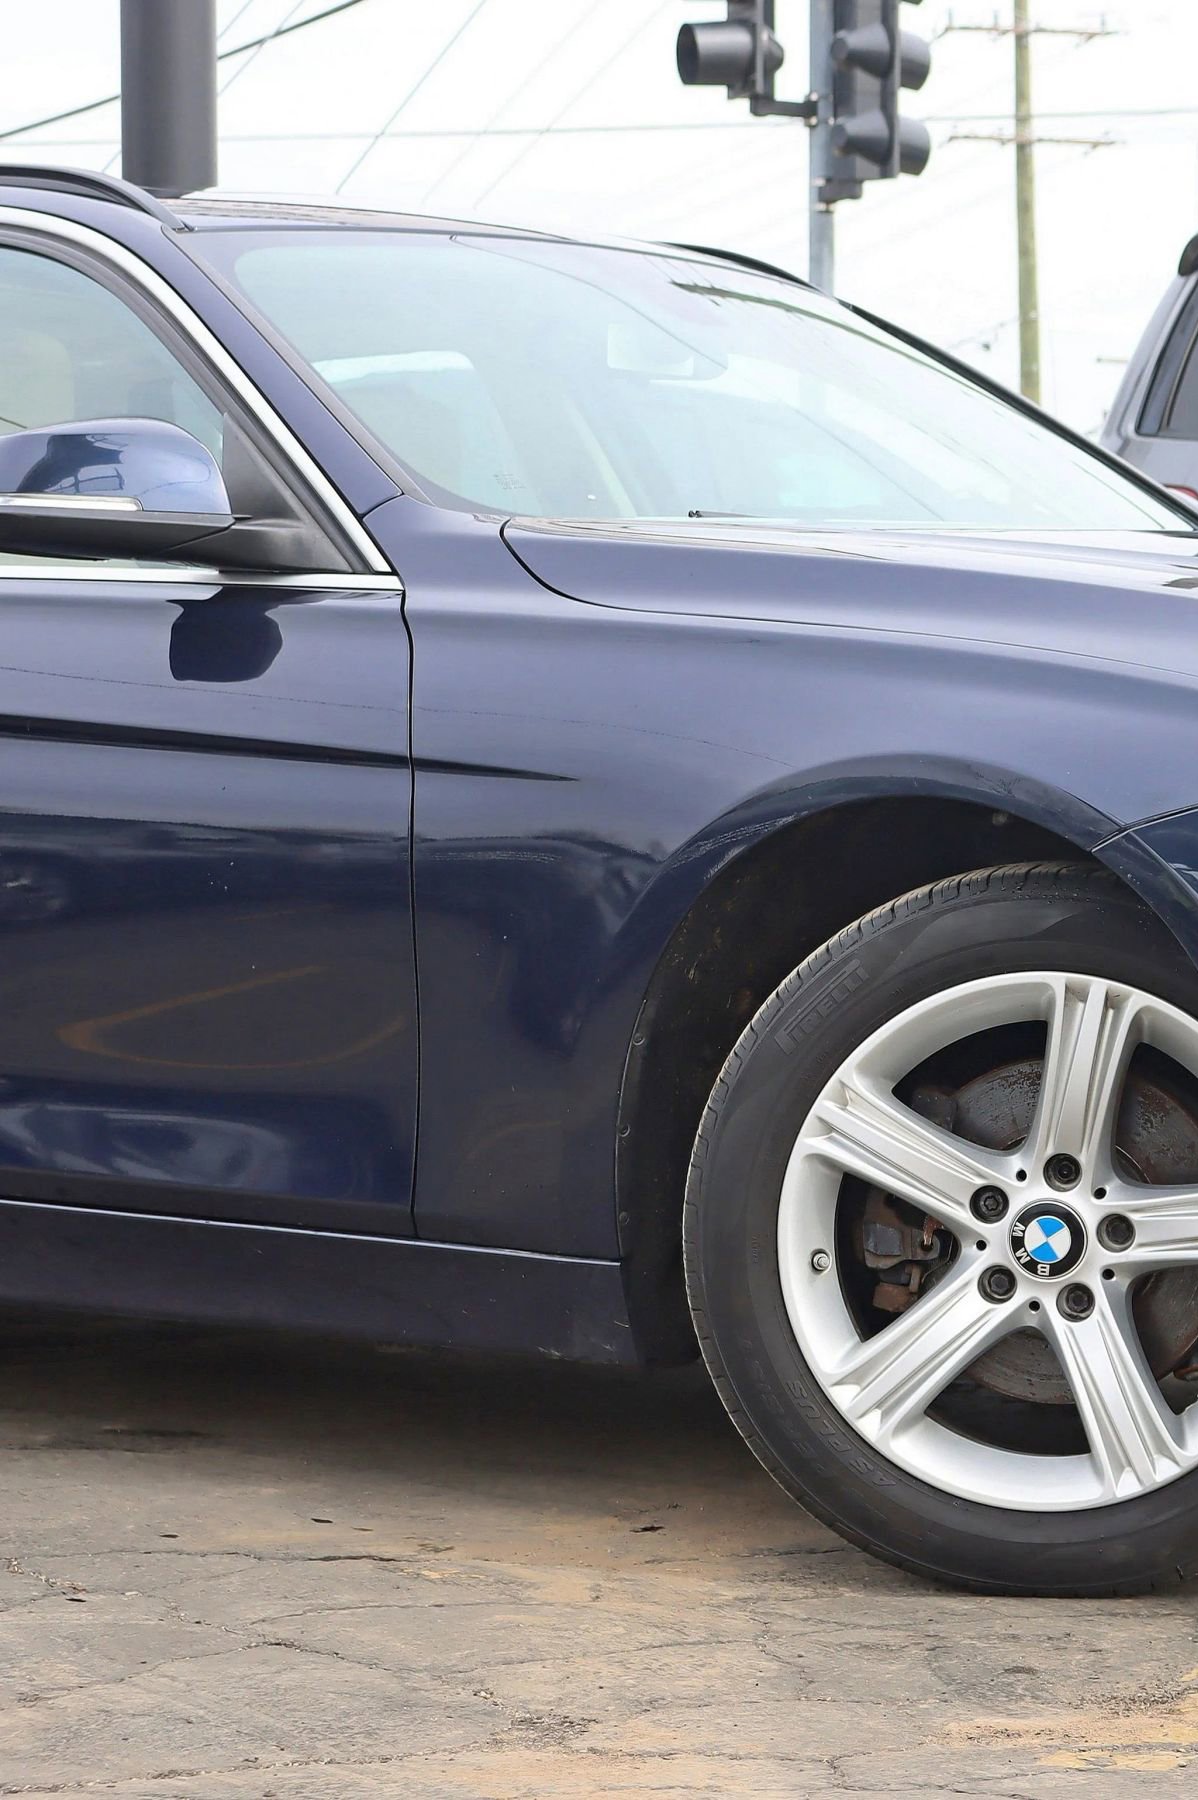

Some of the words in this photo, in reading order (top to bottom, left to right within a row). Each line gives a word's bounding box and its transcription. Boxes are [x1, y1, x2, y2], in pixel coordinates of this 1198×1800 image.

[774, 959, 869, 1055] PIRELLI
[1012, 1221, 1051, 1276] BMW
[785, 1380, 852, 1453] PLUS
